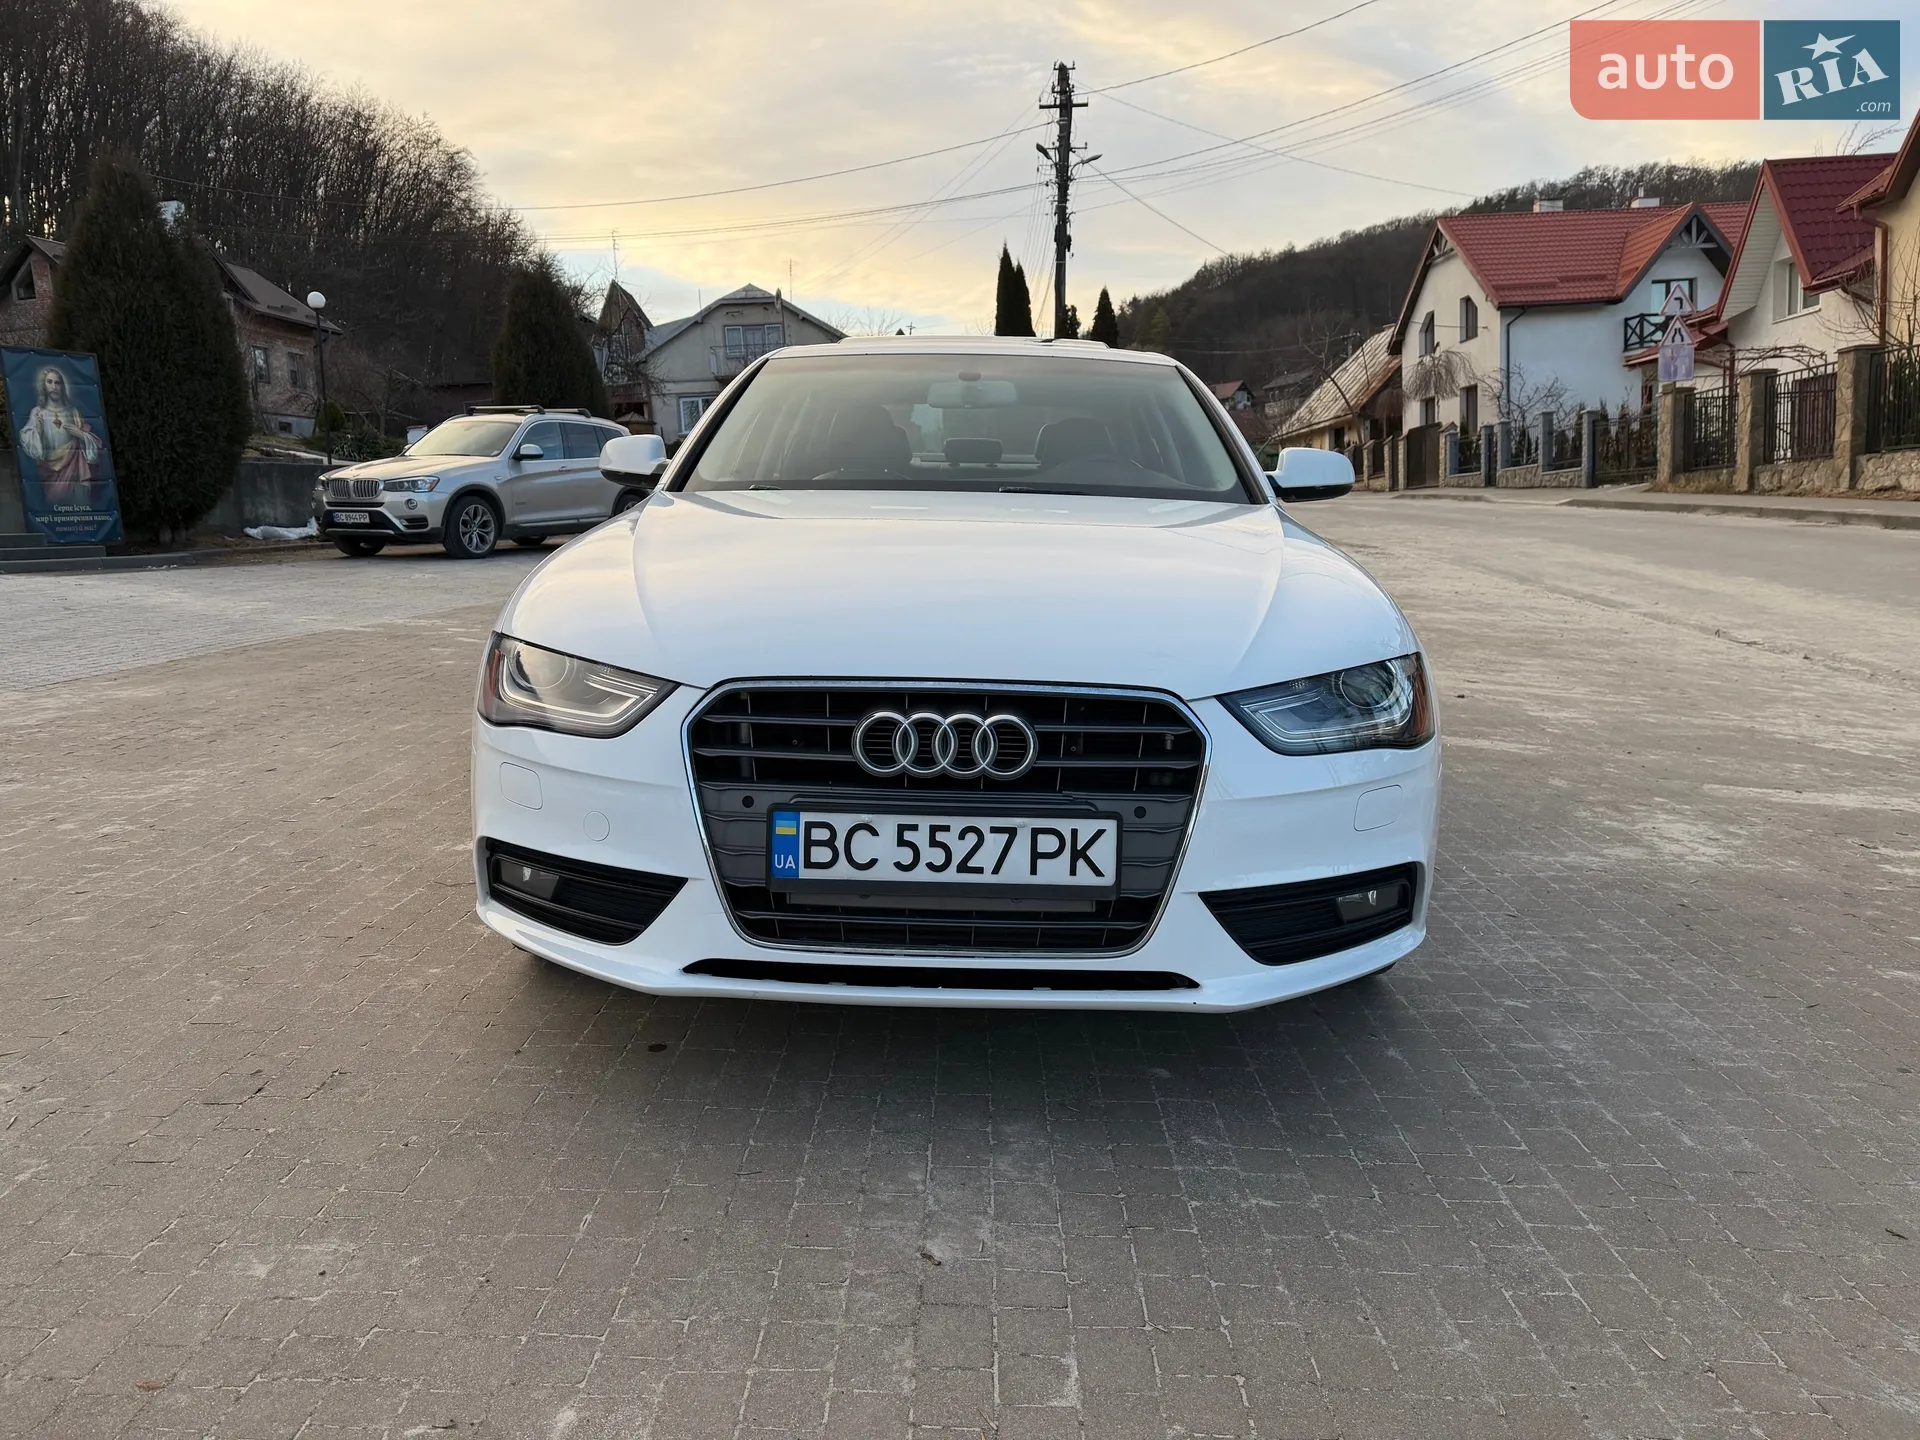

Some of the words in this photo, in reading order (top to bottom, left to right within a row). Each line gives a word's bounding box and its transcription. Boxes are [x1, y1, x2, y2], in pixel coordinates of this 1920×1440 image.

[53, 504, 73, 513] Серце
[803, 820, 880, 871] BC
[893, 823, 1019, 876] 5527
[1029, 826, 1107, 878] PK
[774, 854, 796, 869] UA
